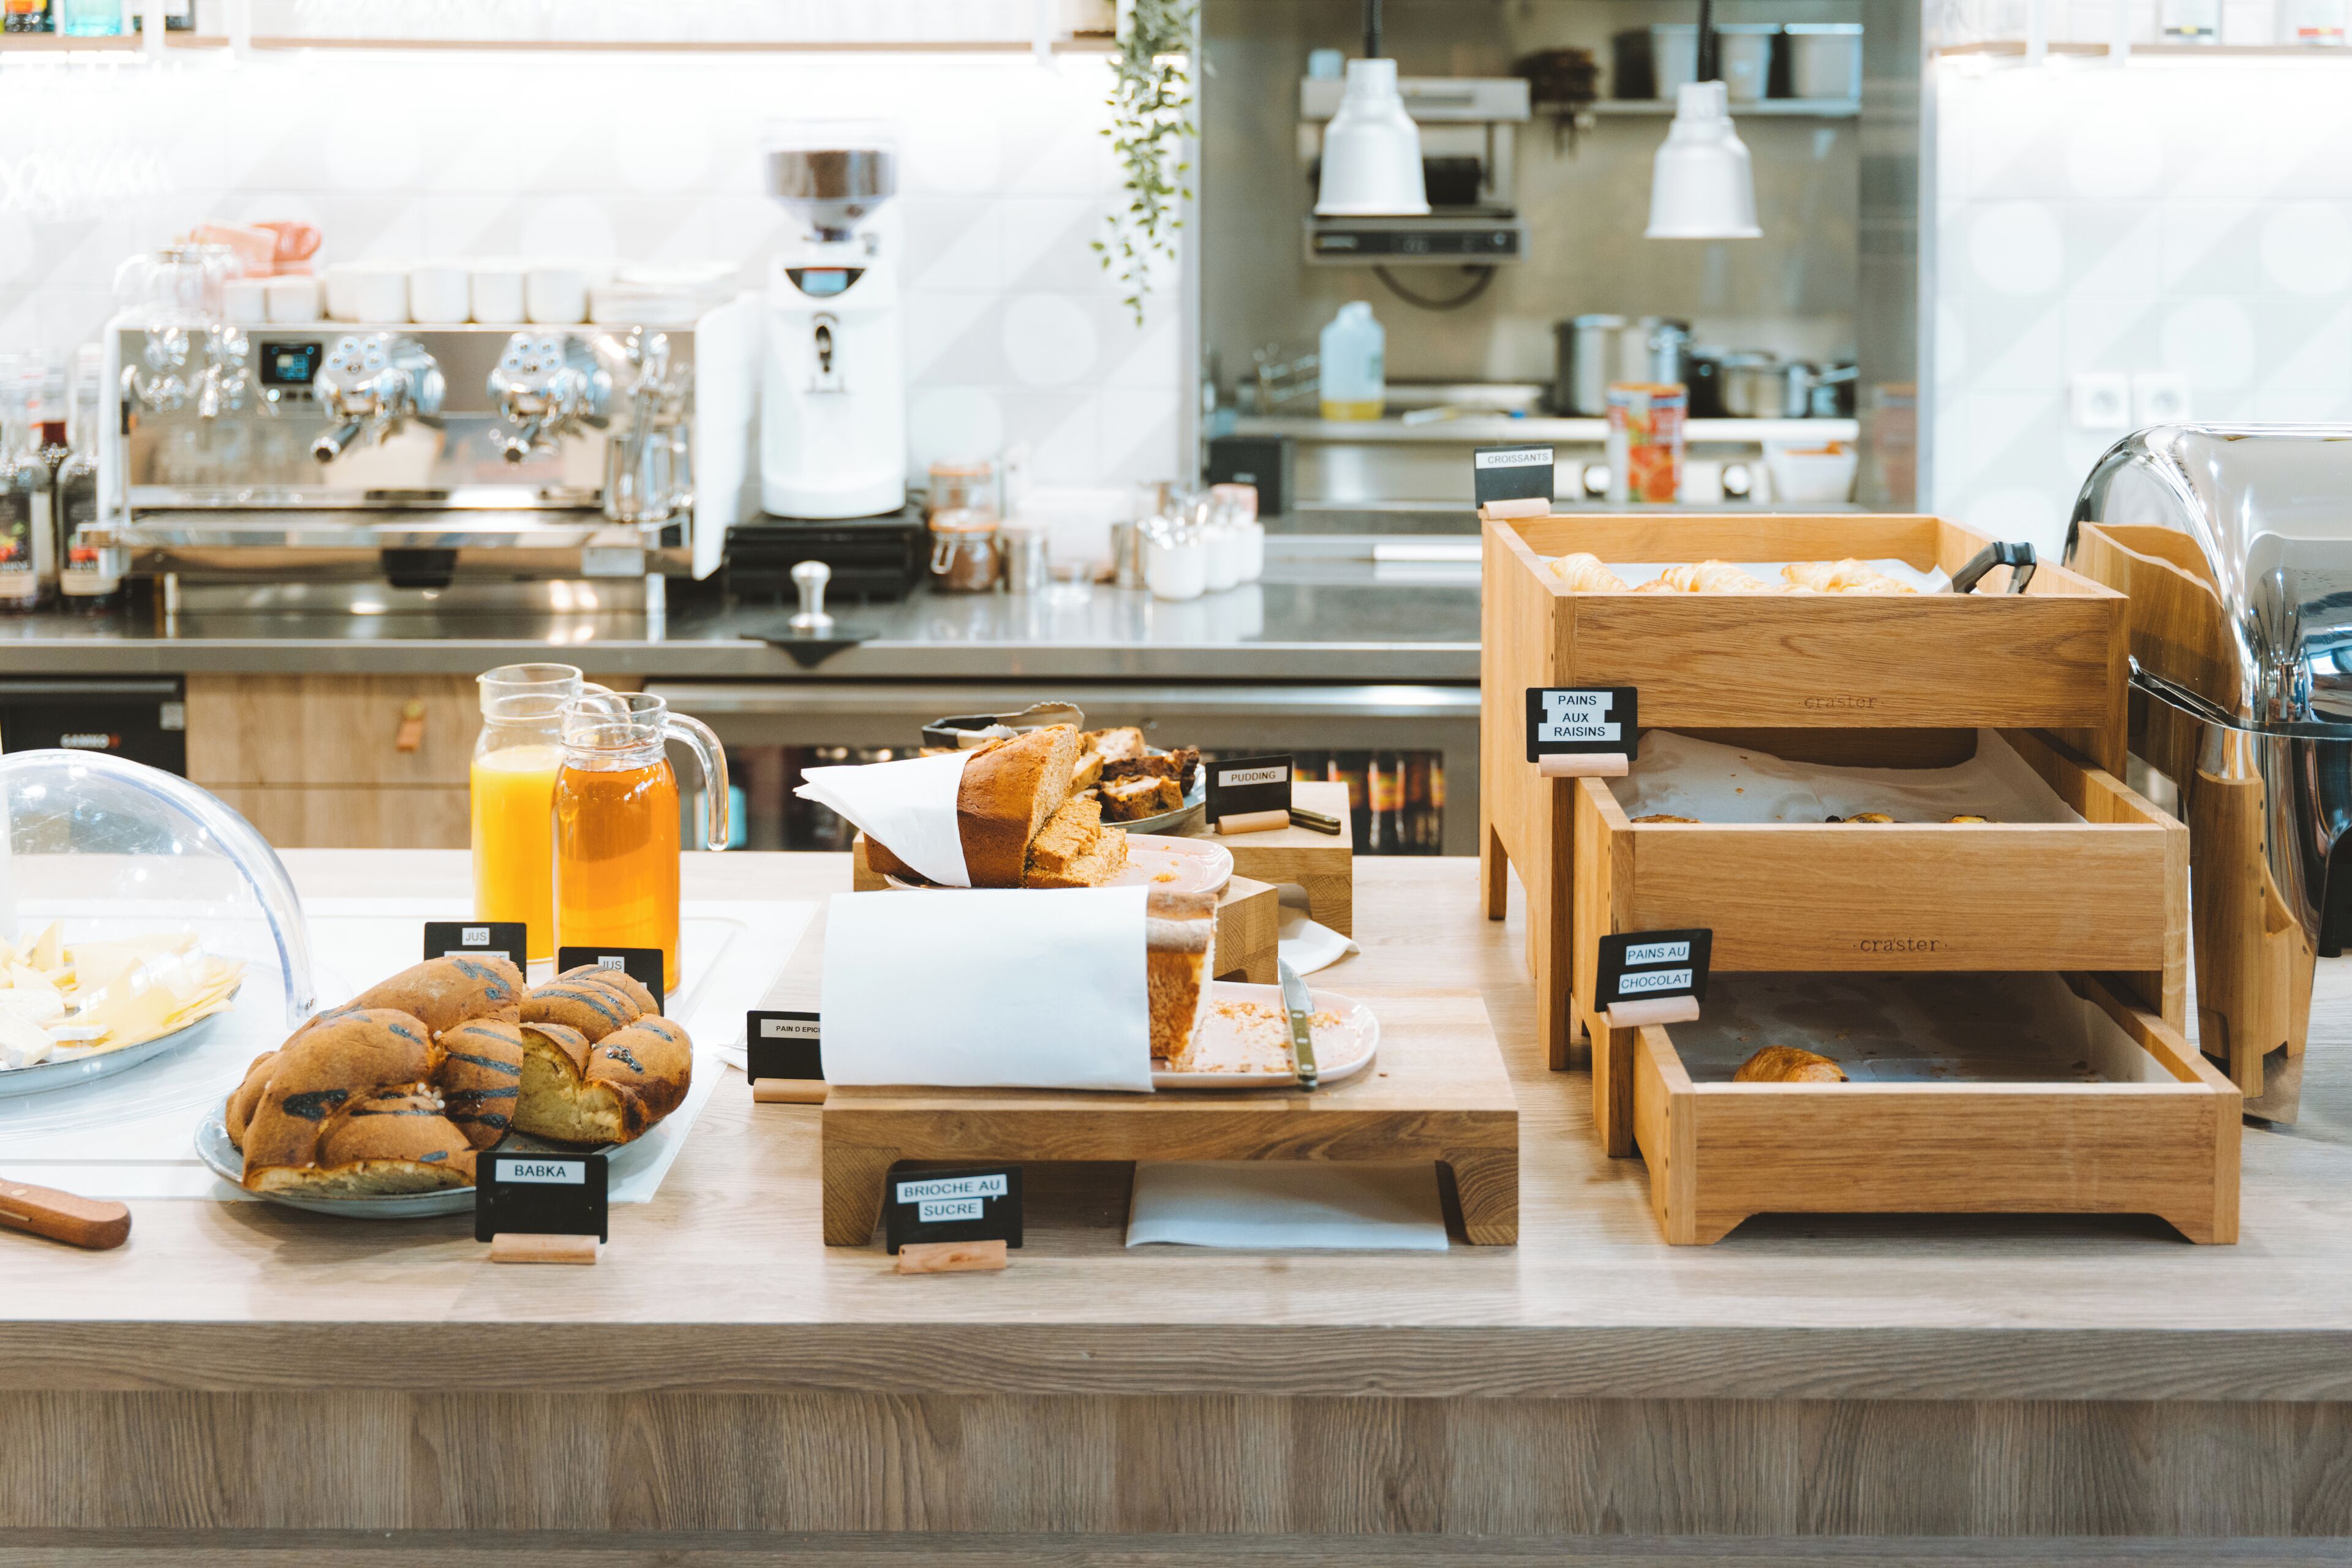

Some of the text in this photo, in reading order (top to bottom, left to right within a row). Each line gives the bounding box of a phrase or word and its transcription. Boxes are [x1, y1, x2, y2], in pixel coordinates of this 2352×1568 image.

[1487, 453, 1548, 464] CROISSANTS
[1558, 695, 1597, 706] PAINS
[1562, 712, 1589, 723] AUX
[1554, 726, 1605, 736] RAISINS
[1231, 771, 1276, 782] PUDDING
[465, 932, 487, 941] JUS
[1627, 946, 1686, 960] PAINS AU
[1621, 973, 1690, 989] CHOCOLAT
[514, 1165, 567, 1177] BABKA
[904, 1179, 1000, 1197] BRIOCHE AU
[924, 1202, 978, 1216] SUCRE
